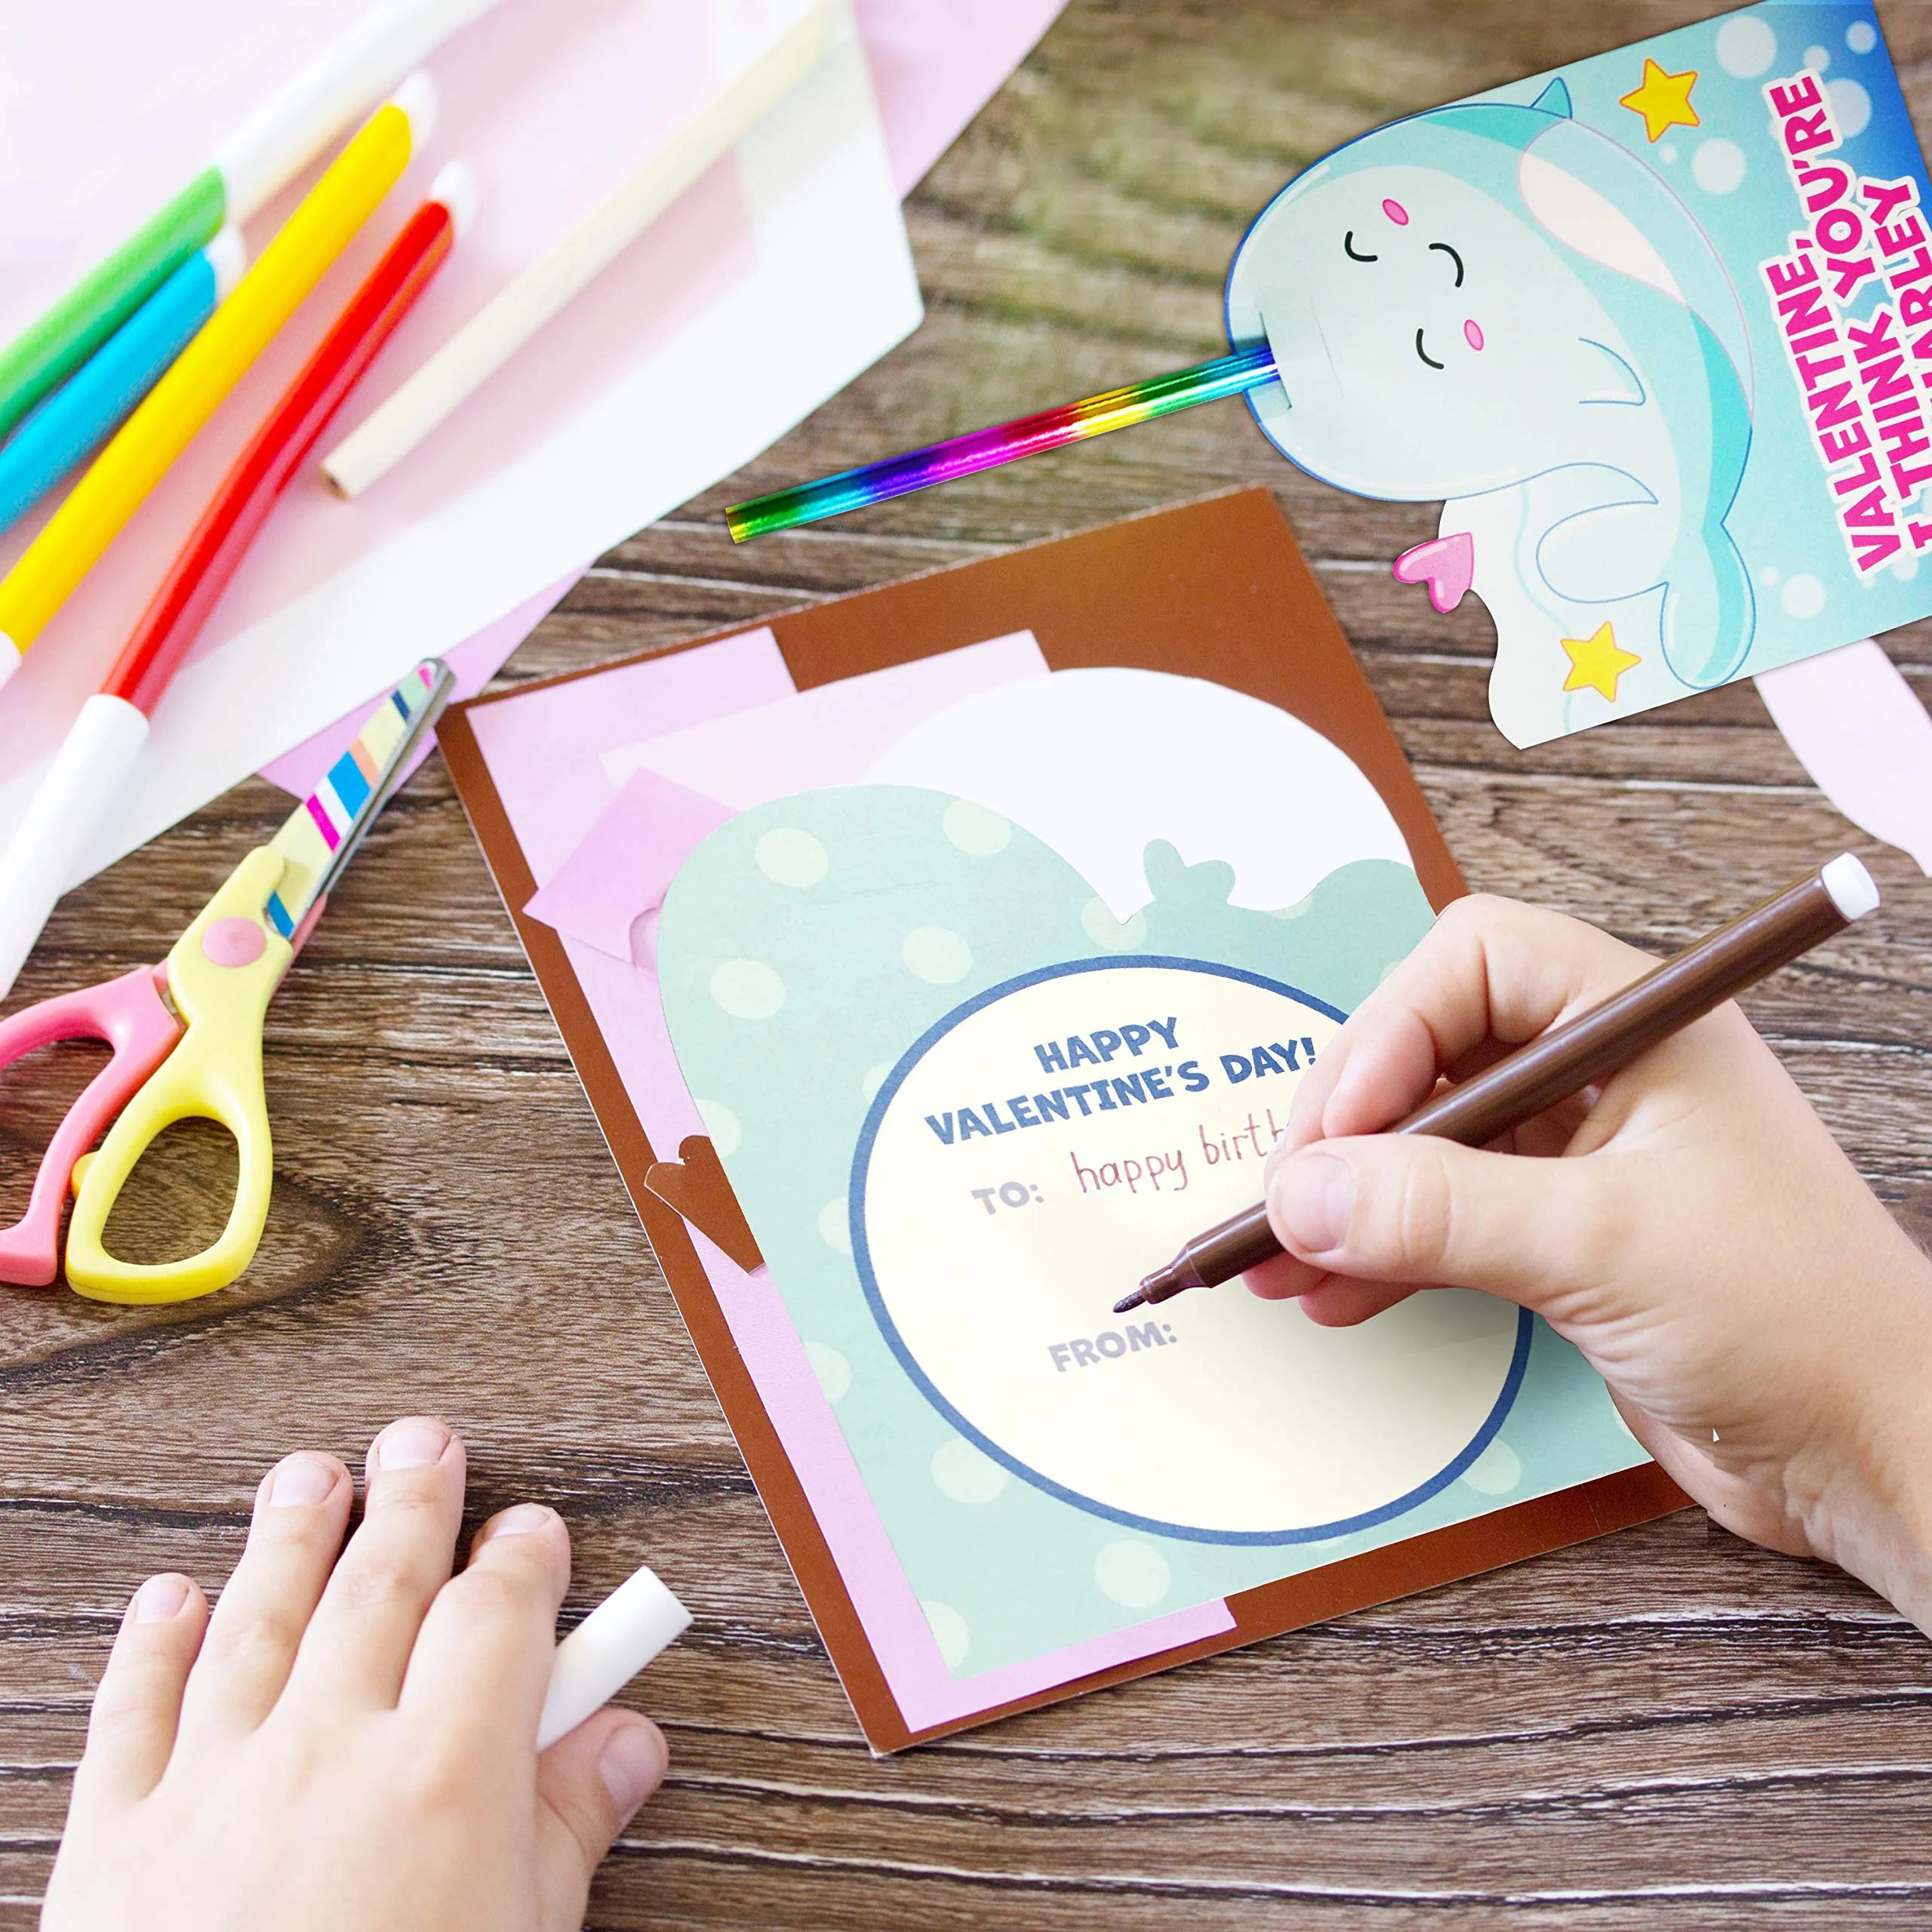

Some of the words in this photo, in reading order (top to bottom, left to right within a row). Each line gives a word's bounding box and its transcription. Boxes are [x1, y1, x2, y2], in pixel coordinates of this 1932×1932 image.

[1770, 75, 1875, 299] YOU'RE
[1766, 238, 1902, 571] VALENTINE,
[1847, 311, 1932, 500] THINK
[1033, 1017, 1179, 1073] HAPPY
[924, 1060, 1210, 1145] VALENTINE'S
[1220, 1037, 1316, 1084] DAY!
[971, 1181, 1044, 1215] TO:
[1070, 1149, 1188, 1194] happy
[1048, 1321, 1177, 1372] FROM:
